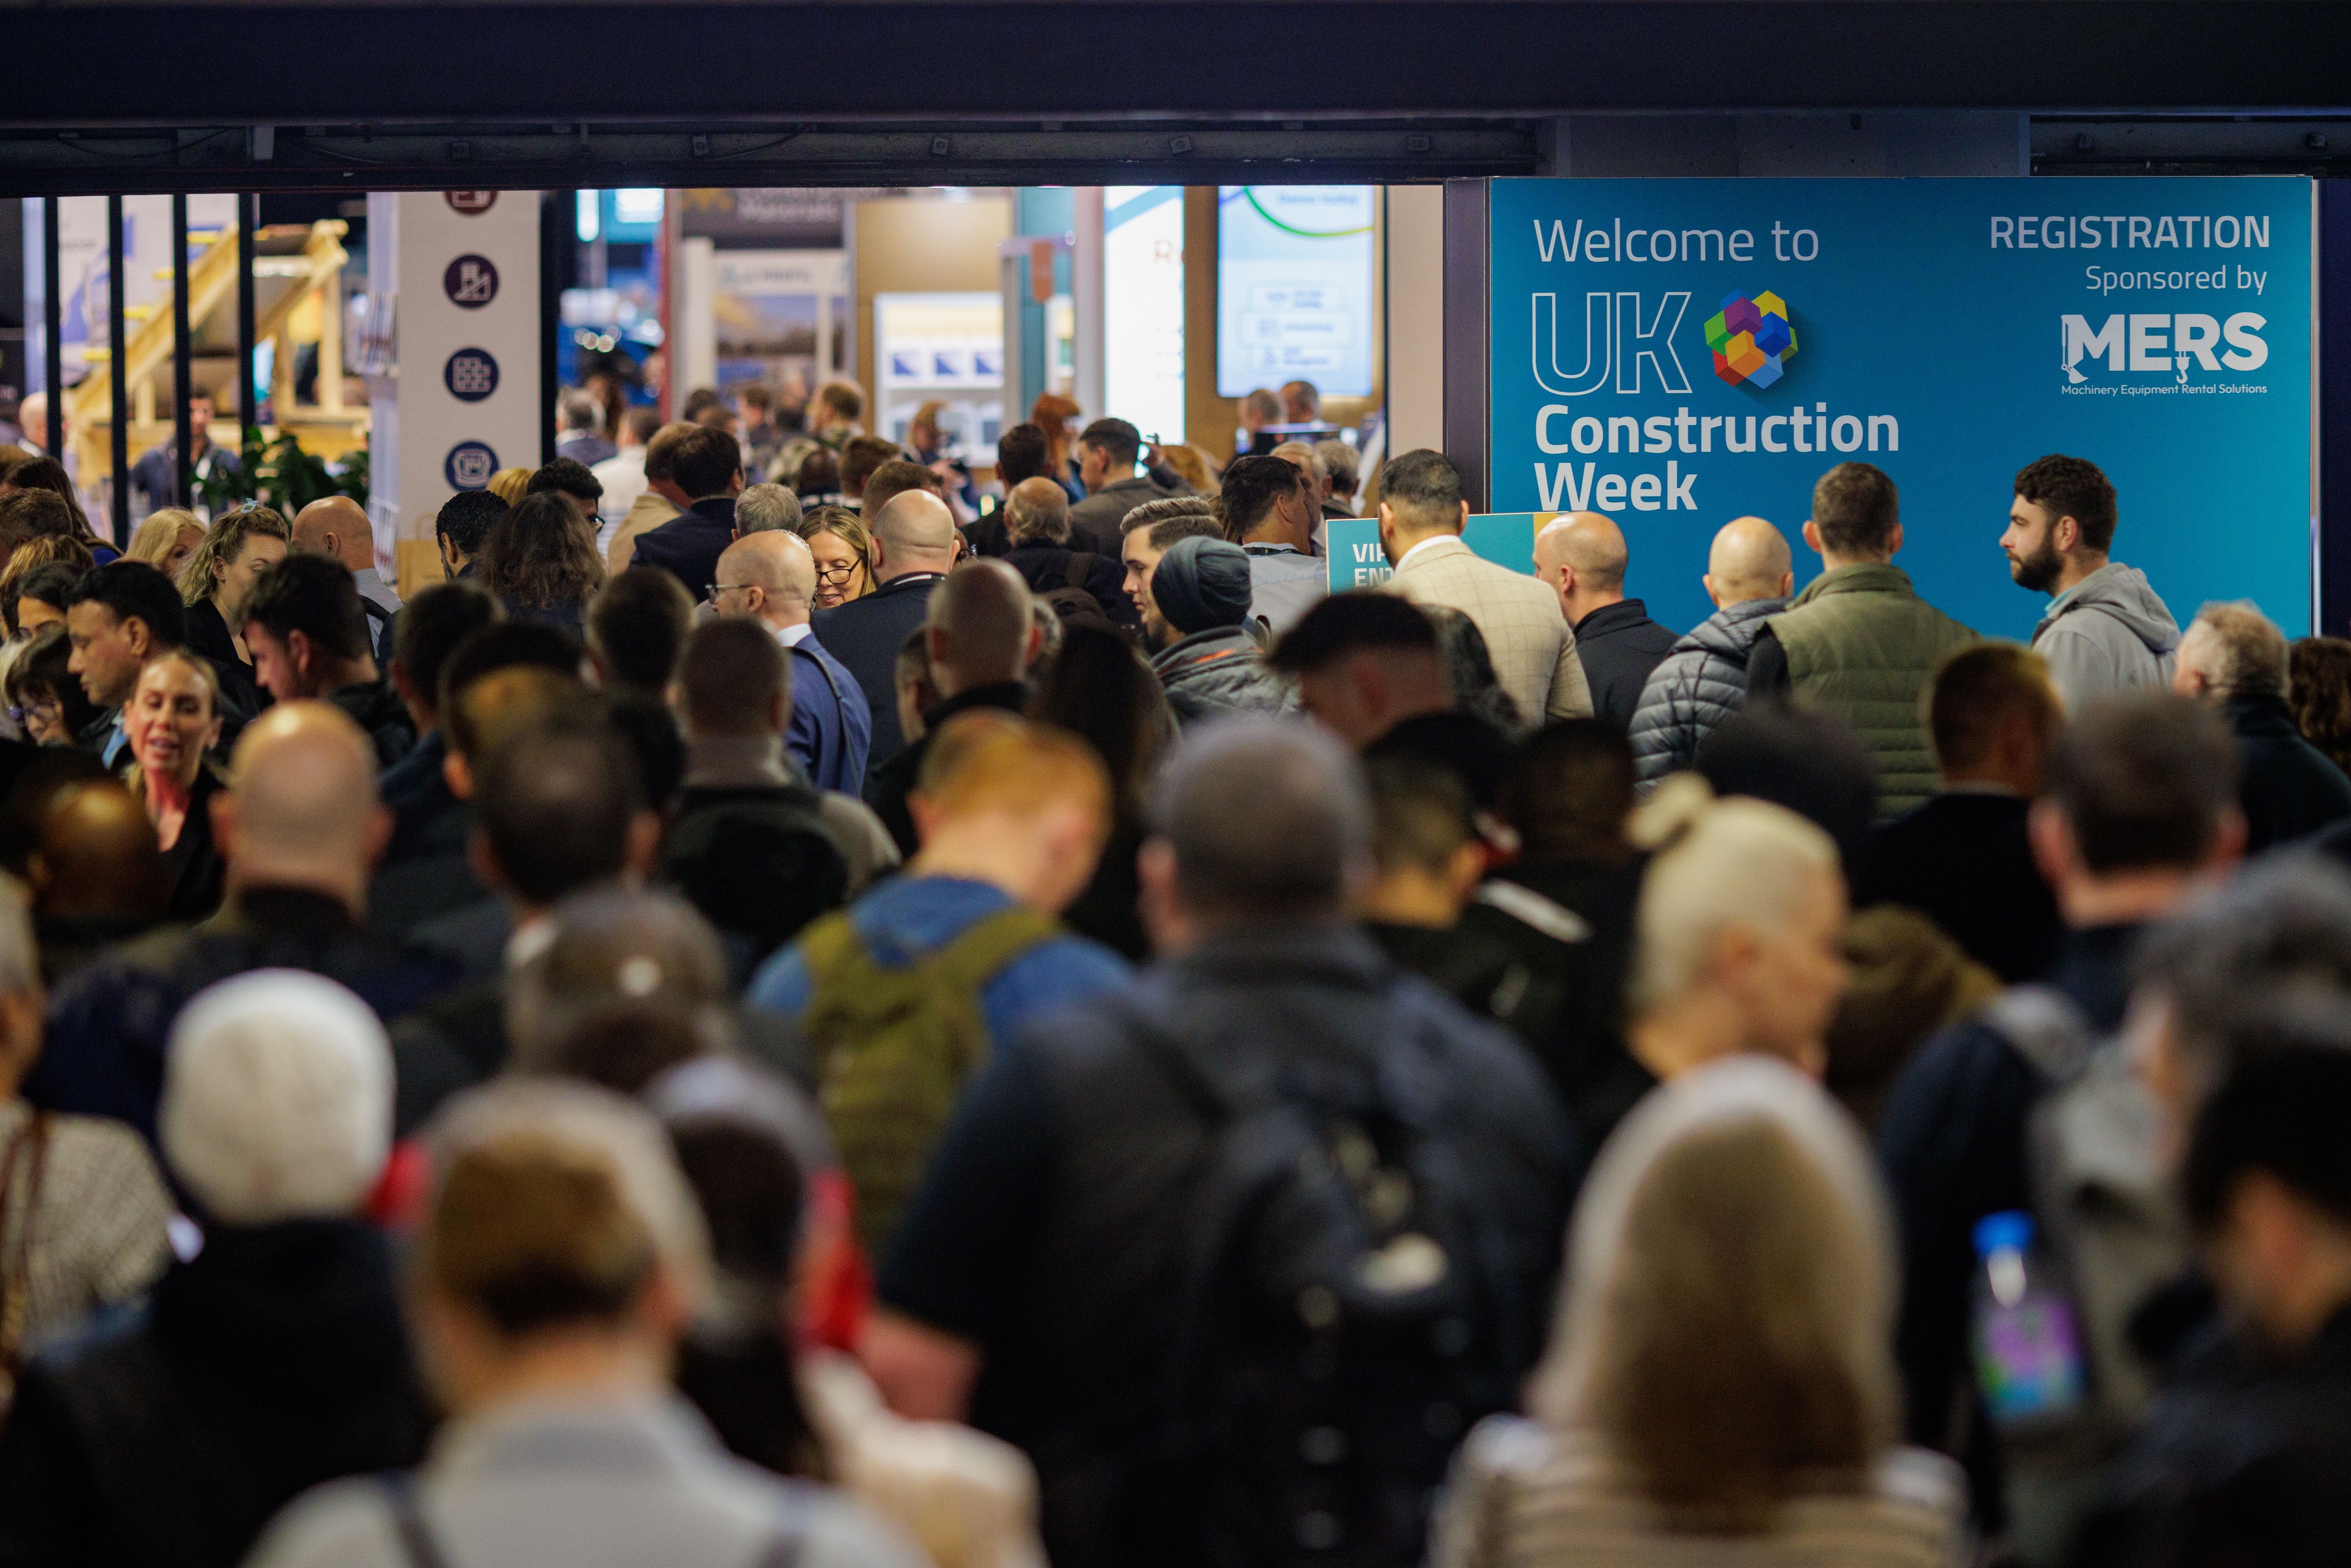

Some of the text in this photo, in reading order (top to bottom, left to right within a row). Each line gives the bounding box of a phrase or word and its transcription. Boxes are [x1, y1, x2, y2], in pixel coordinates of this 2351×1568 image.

[1533, 218, 1819, 262] Welcome to
[1991, 215, 2269, 249] REGISTRATION
[2086, 265, 2267, 296] Sponsored by
[1532, 292, 1693, 396] UK
[2061, 312, 2268, 384] MERS
[2061, 384, 2267, 396] Machinery Equipment Rental Solutions
[1535, 402, 1899, 455] Construction
[1534, 460, 1698, 512] Week
